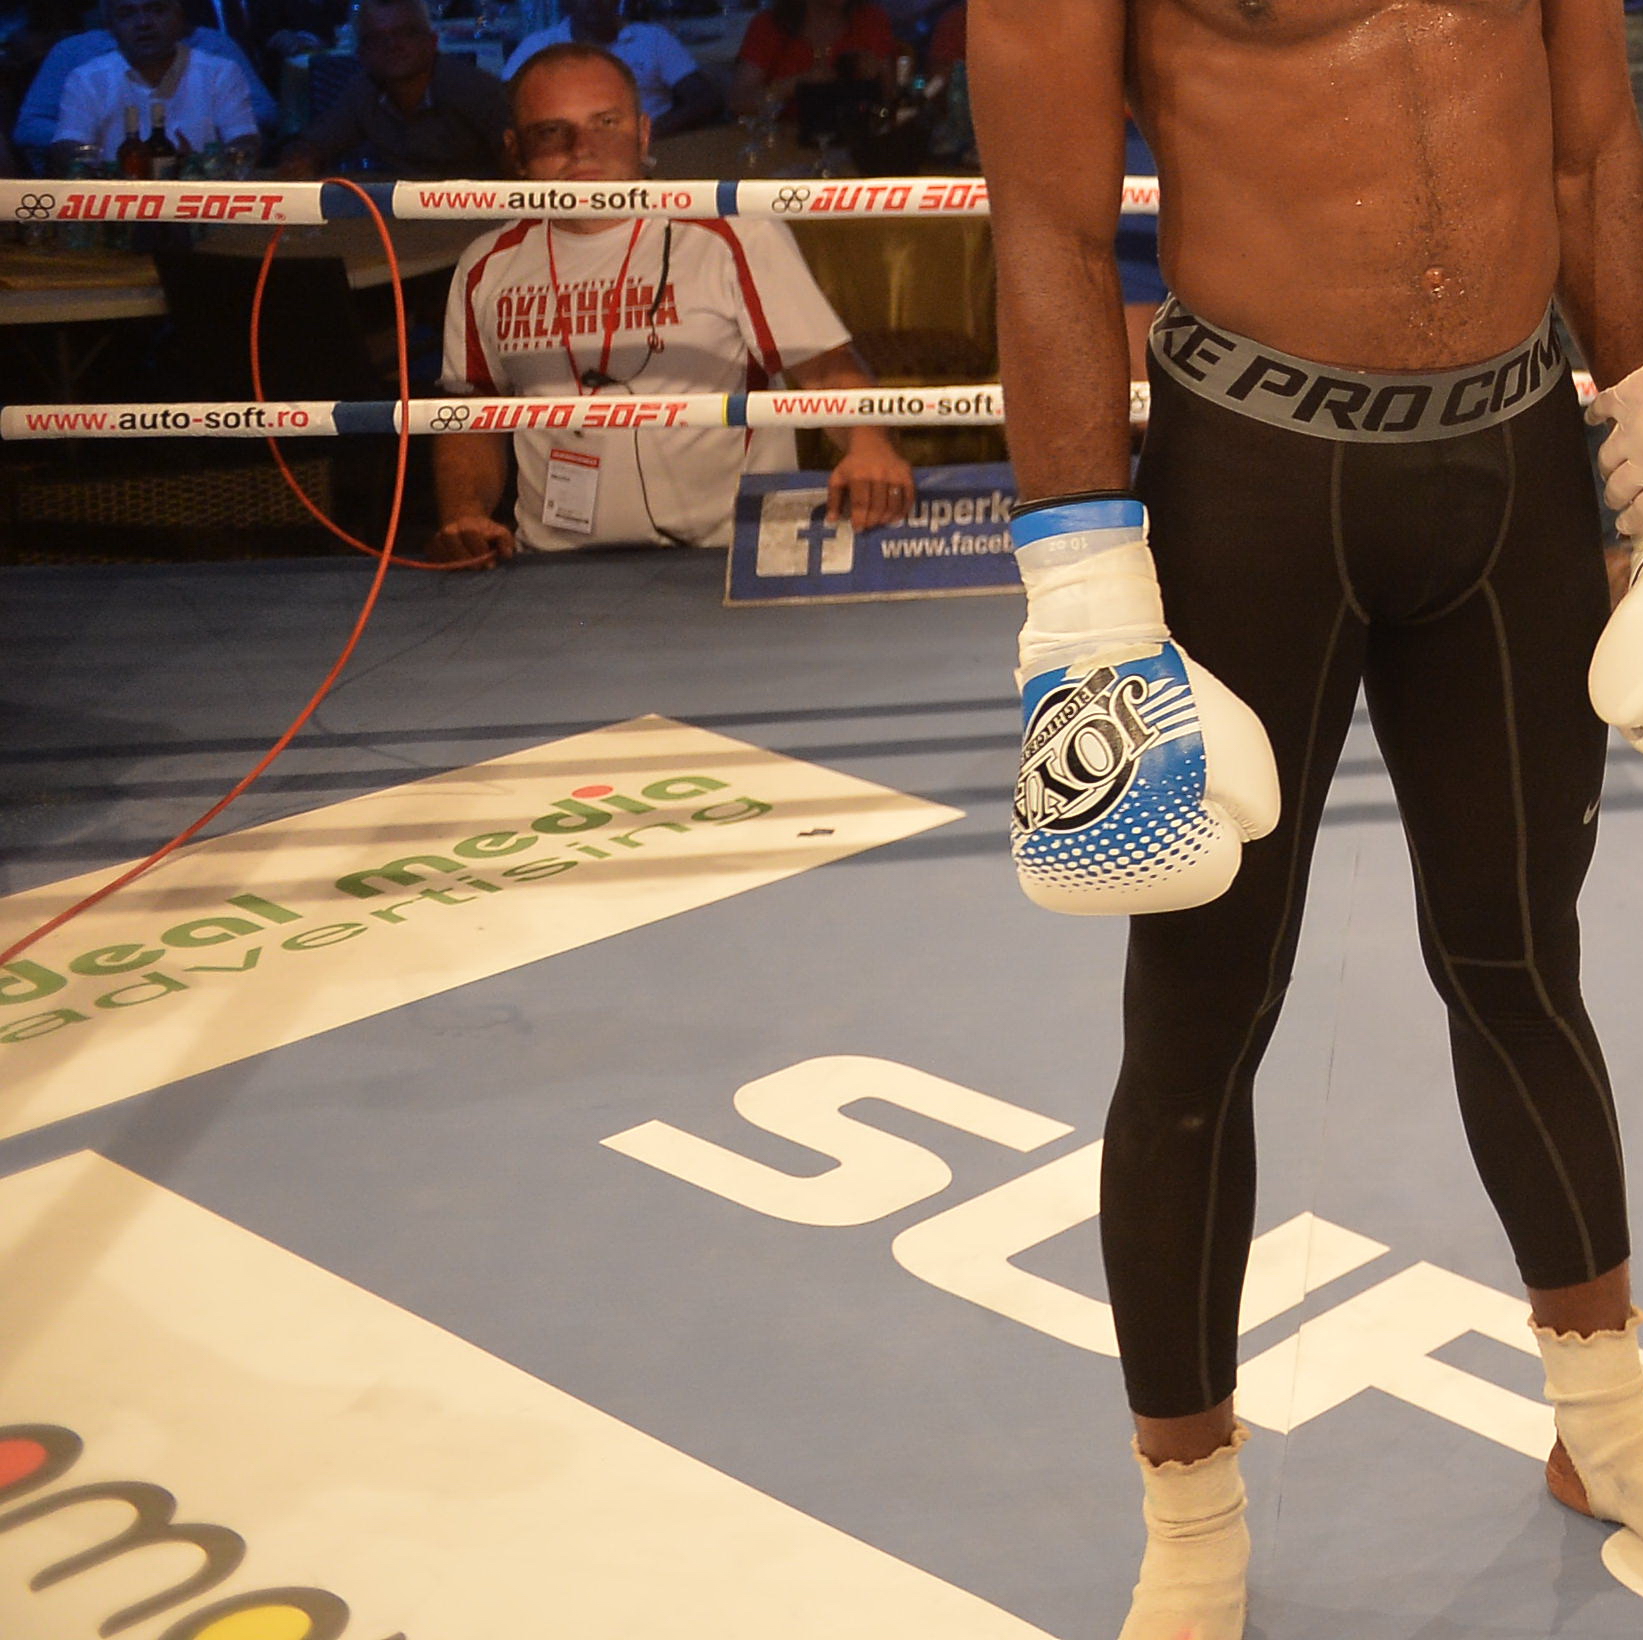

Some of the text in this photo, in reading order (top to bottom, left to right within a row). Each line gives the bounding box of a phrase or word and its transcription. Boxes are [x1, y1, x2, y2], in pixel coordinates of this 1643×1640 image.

[58, 194, 284, 221] AUTO SOFT
[420, 188, 692, 211] www.auto-soft.ro
[809, 185, 990, 213] AUTO SOF
[497, 282, 680, 340] OKLAHOMA
[1226, 355, 1433, 432] PRO
[1440, 329, 1563, 426] COM
[470, 402, 687, 429] AUTO SOFT
[773, 392, 1003, 416] www.auto-soft.
[26, 406, 309, 433] www.auto-soft.ro
[334, 768, 731, 900] media
[0, 792, 774, 1045] advertising
